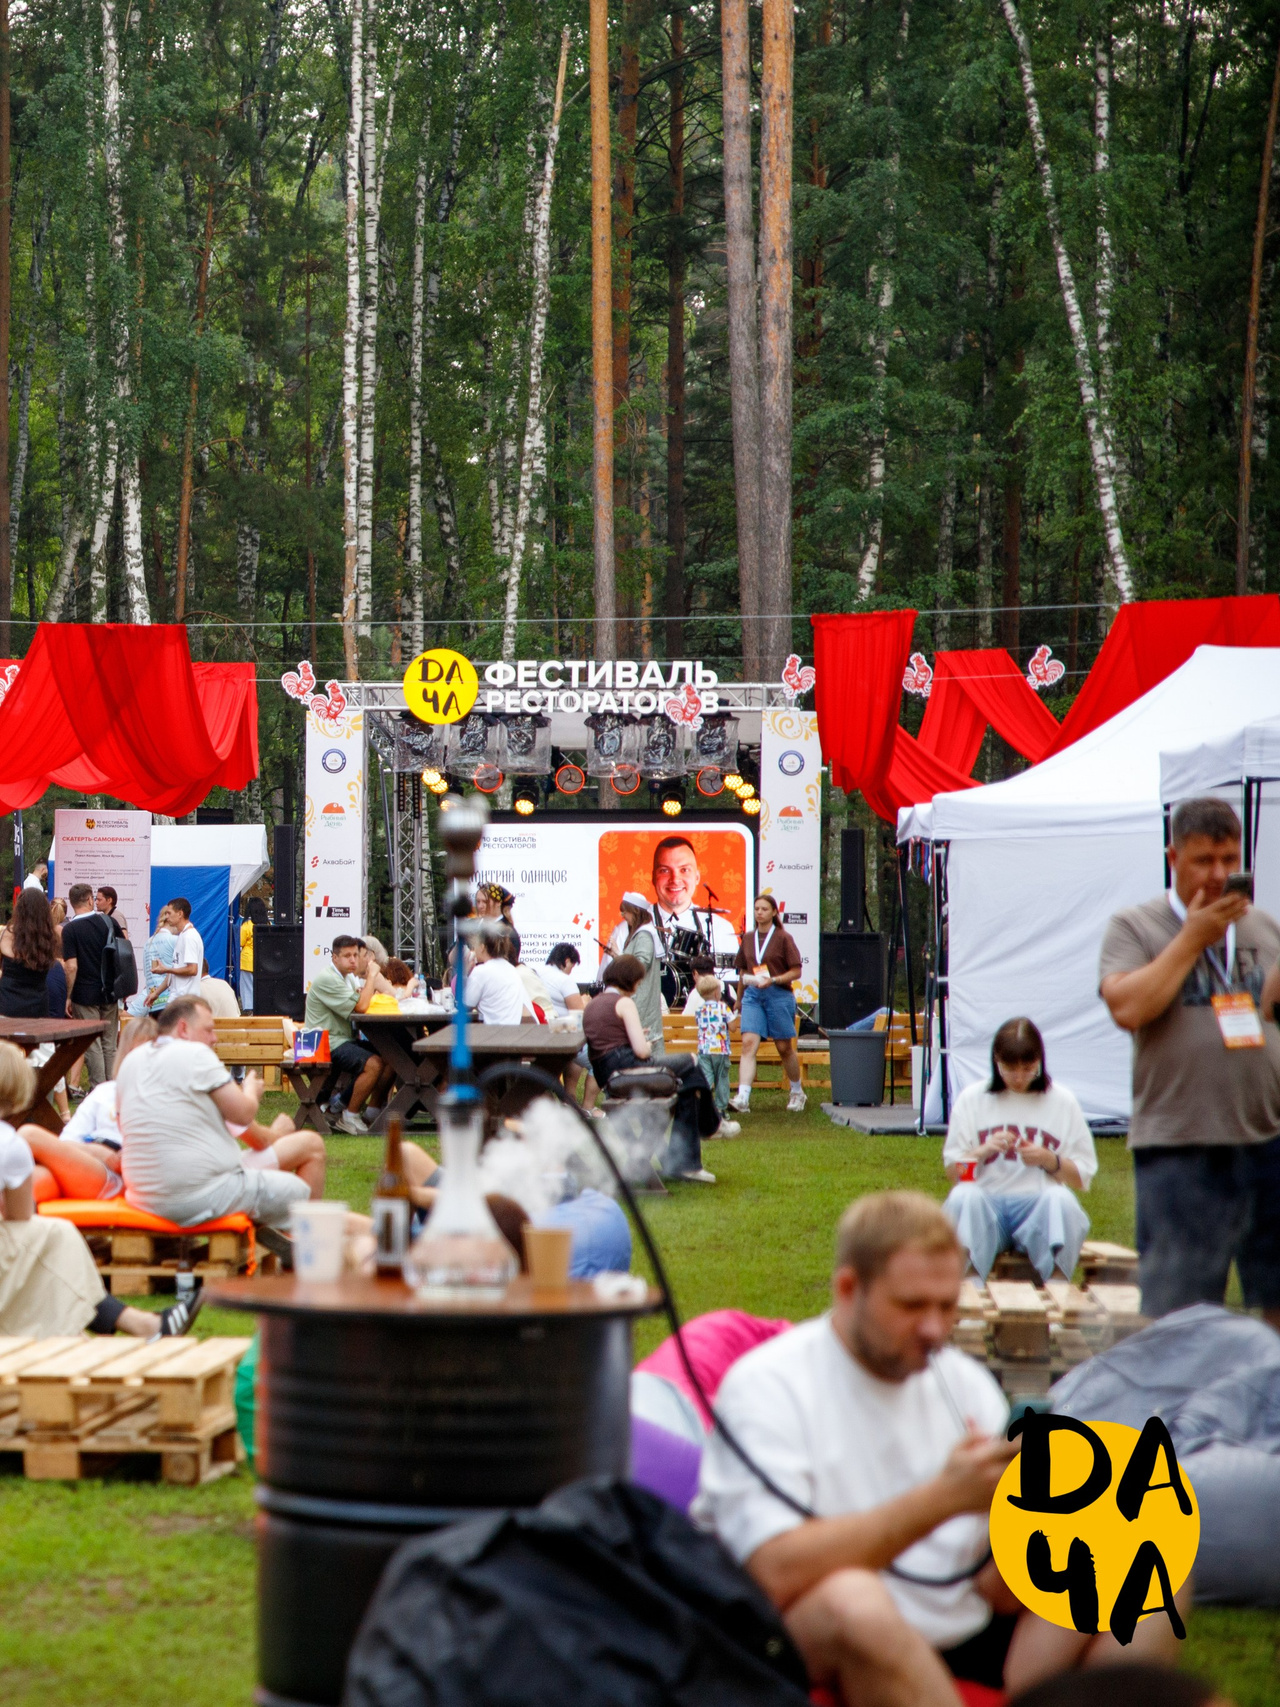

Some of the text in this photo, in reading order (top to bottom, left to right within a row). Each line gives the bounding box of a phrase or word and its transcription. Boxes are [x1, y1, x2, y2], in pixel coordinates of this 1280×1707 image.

[418, 657, 464, 685] DA
[484, 660, 719, 688] ФЕСТИВАЛЬ
[470, 868, 568, 886] МИТРИЙ ОДИНЦОВ
